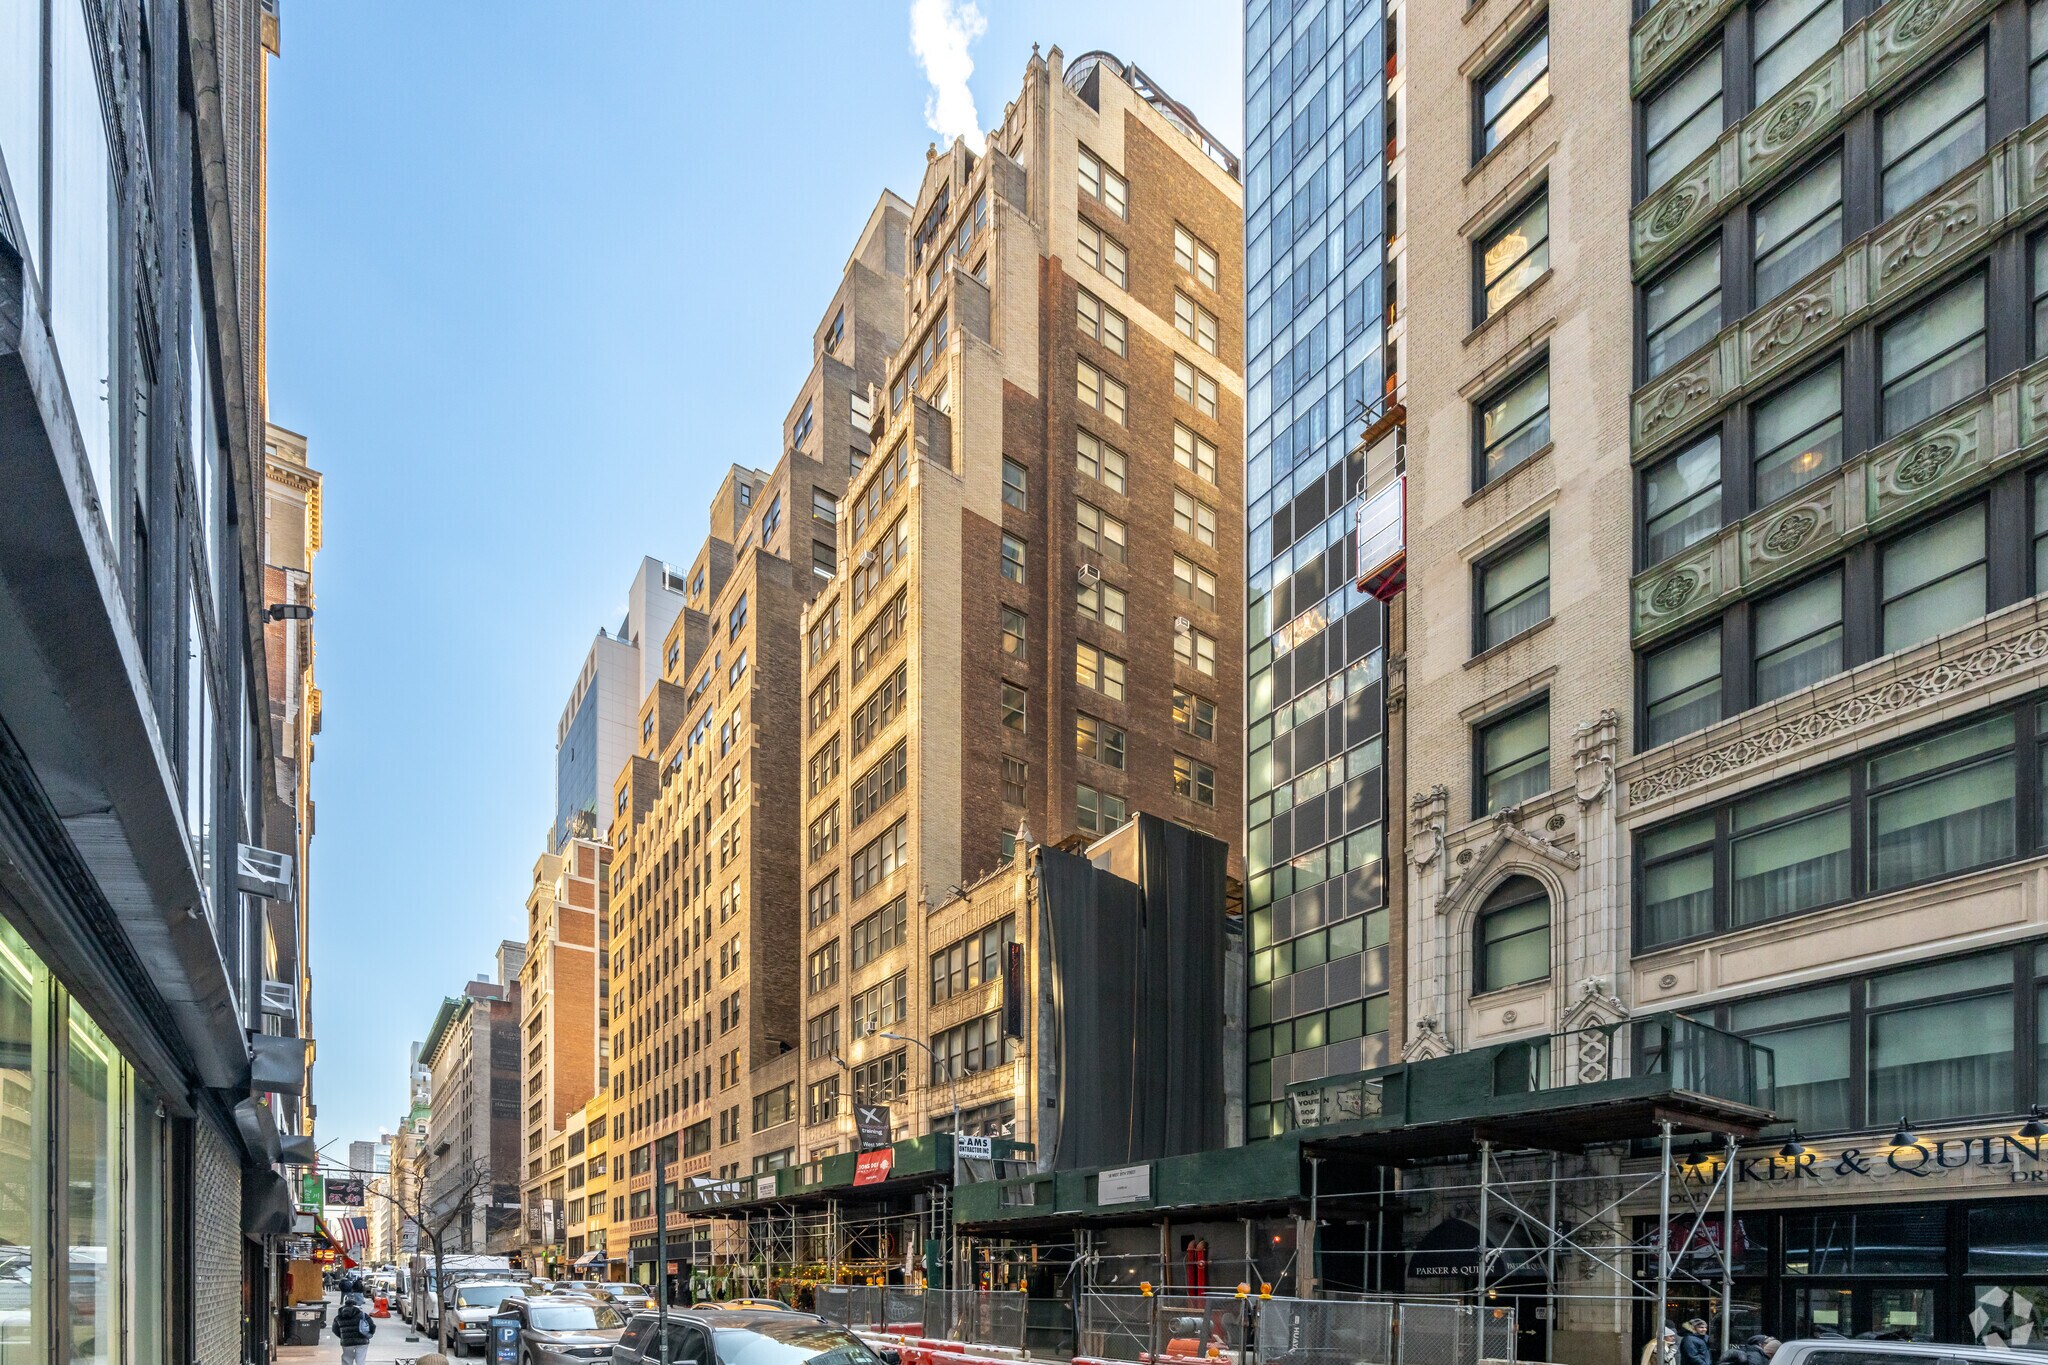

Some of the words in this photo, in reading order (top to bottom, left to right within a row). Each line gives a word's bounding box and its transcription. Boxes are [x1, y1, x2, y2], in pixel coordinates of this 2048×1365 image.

[861, 1128, 883, 1136] training
[967, 1138, 988, 1147] AMS
[959, 1146, 982, 1154] ONTRACTOR
[1834, 1148, 1871, 1176] &
[1670, 1193, 1709, 1204] OOD
[1416, 1266, 1449, 1275] PARKER
[1451, 1266, 1458, 1274] &
[1460, 1265, 1495, 1276] QUIN
[504, 1329, 514, 1341] P
